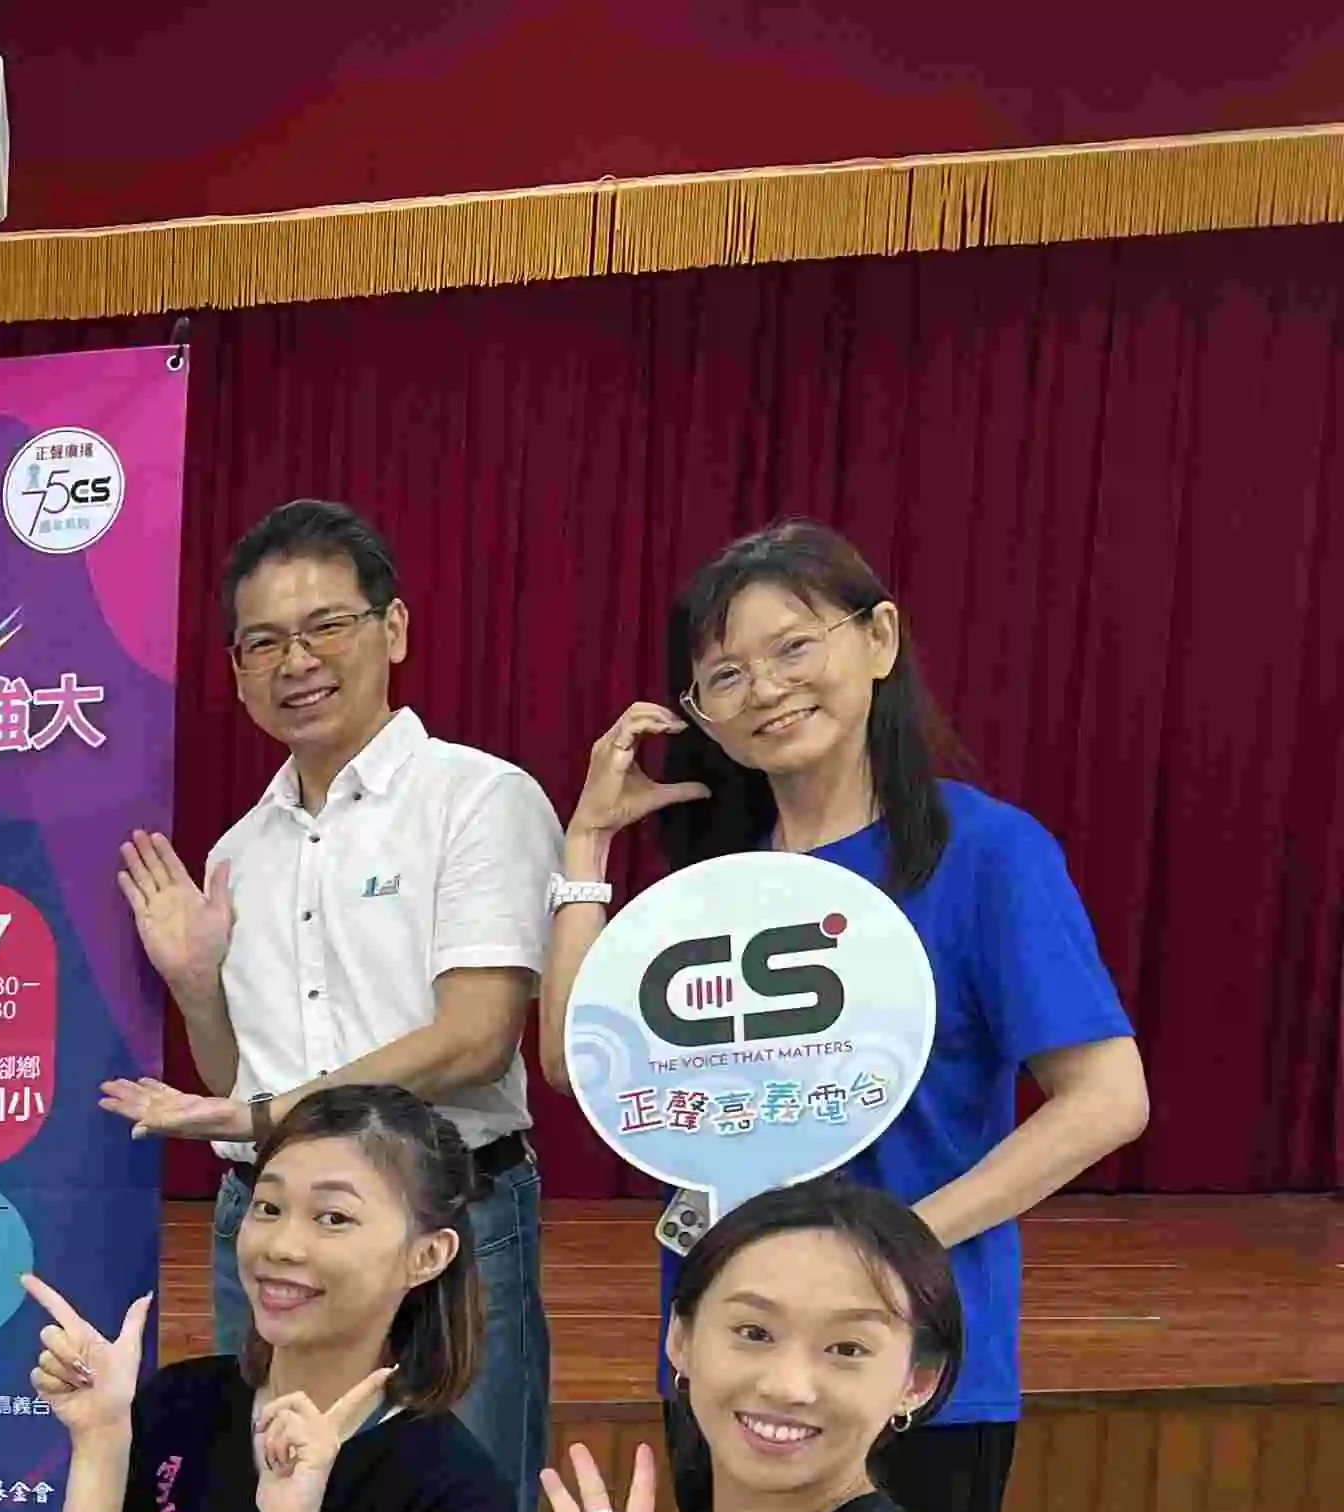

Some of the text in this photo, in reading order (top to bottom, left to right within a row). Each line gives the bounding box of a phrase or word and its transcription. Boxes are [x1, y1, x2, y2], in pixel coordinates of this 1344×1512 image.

[649, 1040, 854, 1074] THE VOICE THAT MATTERS
[617, 1070, 889, 1135] 正聲嘉義電台
